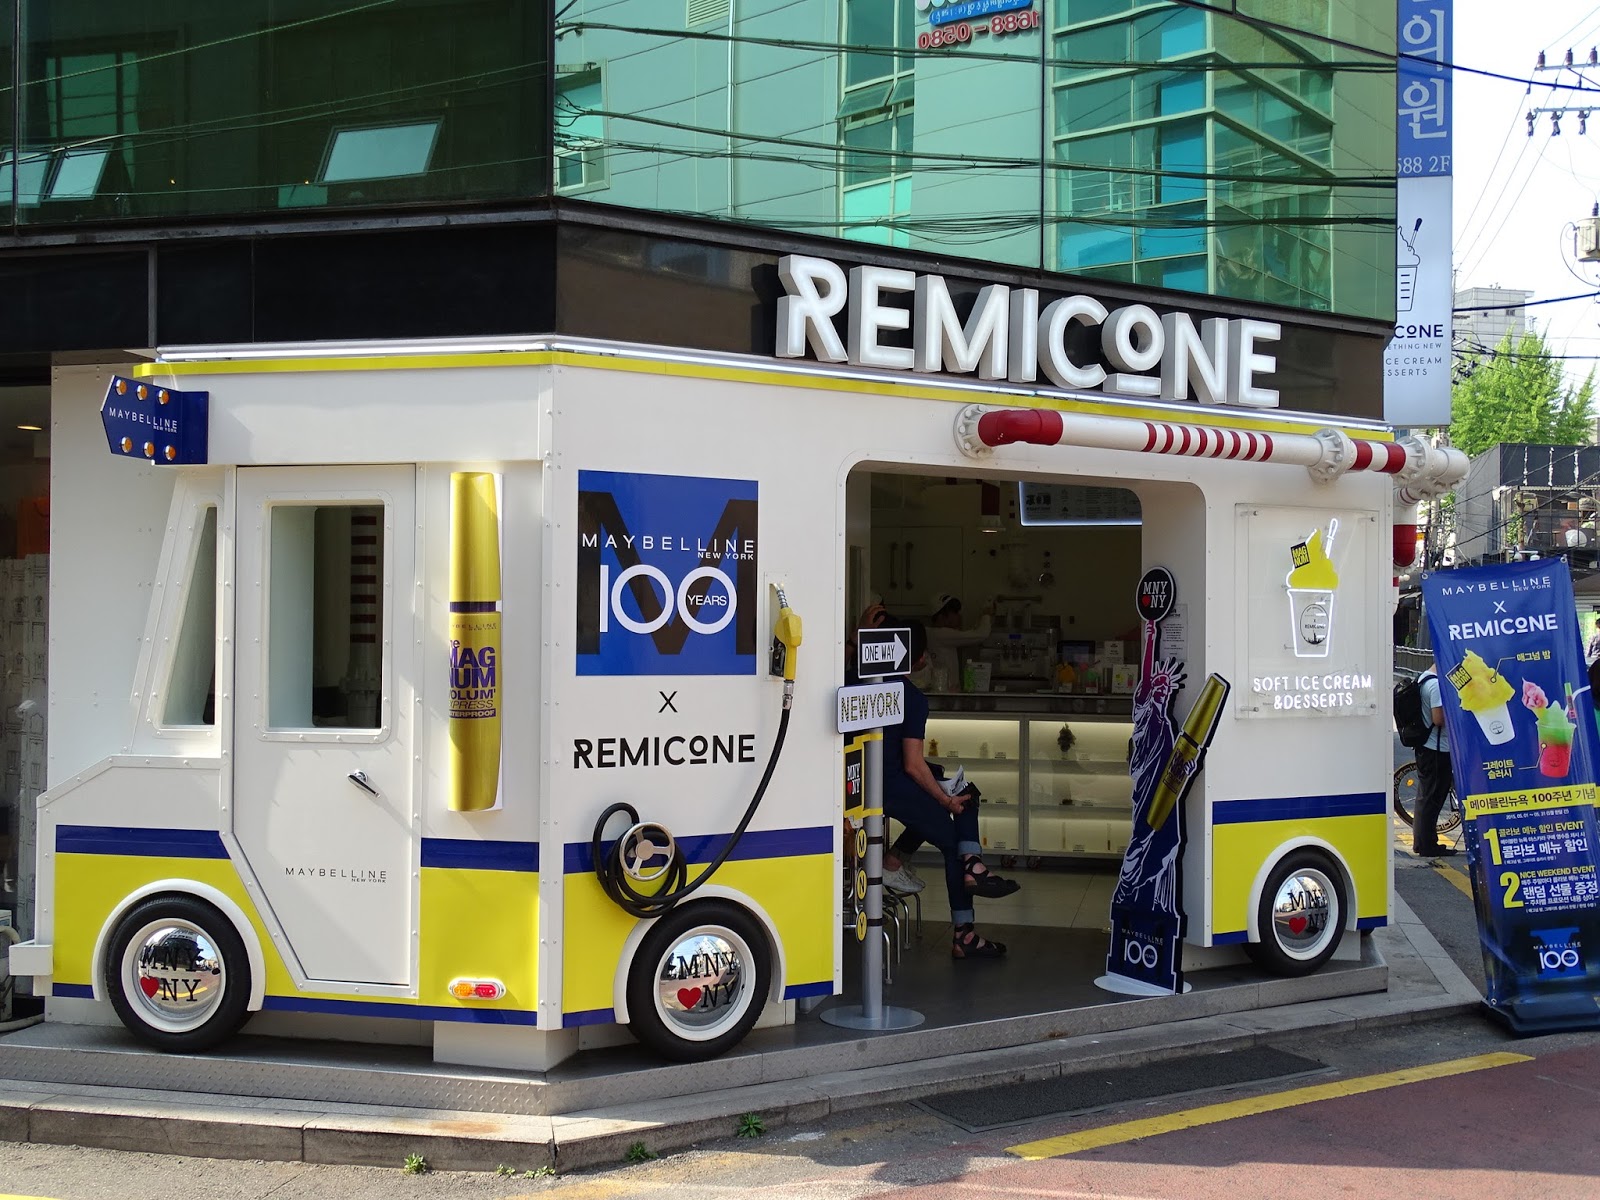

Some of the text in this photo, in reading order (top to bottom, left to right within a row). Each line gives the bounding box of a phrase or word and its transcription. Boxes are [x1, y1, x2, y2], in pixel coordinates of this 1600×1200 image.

[1398, 0, 1447, 139] 의원
[1429, 155, 1450, 173] 2F
[775, 253, 1282, 408] REMICONE
[1394, 324, 1444, 339] CONE
[1385, 357, 1442, 365] CE CREAM
[1384, 368, 1428, 376] SSERTS
[109, 407, 178, 430] MAYBELLINE
[582, 533, 755, 554] MAYBELLINE
[697, 552, 754, 560] NEW YORK
[1143, 581, 1168, 595] MNY
[1442, 576, 1550, 596] MAYBELLINE
[600, 564, 737, 635] 100
[687, 595, 727, 606] YEARS
[1150, 594, 1167, 608] NY
[1448, 613, 1558, 640] REMICONE
[864, 644, 895, 661] ONE WAY
[1253, 674, 1372, 692] SOFT ICE CREAM
[450, 688, 496, 700] OLUM'
[1273, 692, 1354, 710] &DESSERTS
[573, 734, 755, 769] REMICONE
[1482, 759, 1515, 770] 그레이트
[1487, 768, 1512, 780] 슬러시
[1531, 790, 1572, 804] 100주년
[1575, 787, 1596, 800] 기념
[1498, 820, 1584, 837] 콜라보 메뉴 할인 EVENT
[1483, 827, 1502, 866] 1
[1502, 838, 1589, 859] 콜라보 메뉴 할인
[285, 867, 387, 879] MAYBELLINE
[1520, 865, 1596, 879] NICE WEEKEND EVENT
[1499, 871, 1524, 909] 2
[1522, 880, 1599, 900] 랜덤 선물 증정
[677, 951, 735, 980] MNY
[1539, 950, 1579, 970] 100
[160, 978, 201, 1002] NY
[700, 981, 734, 1008] NY
